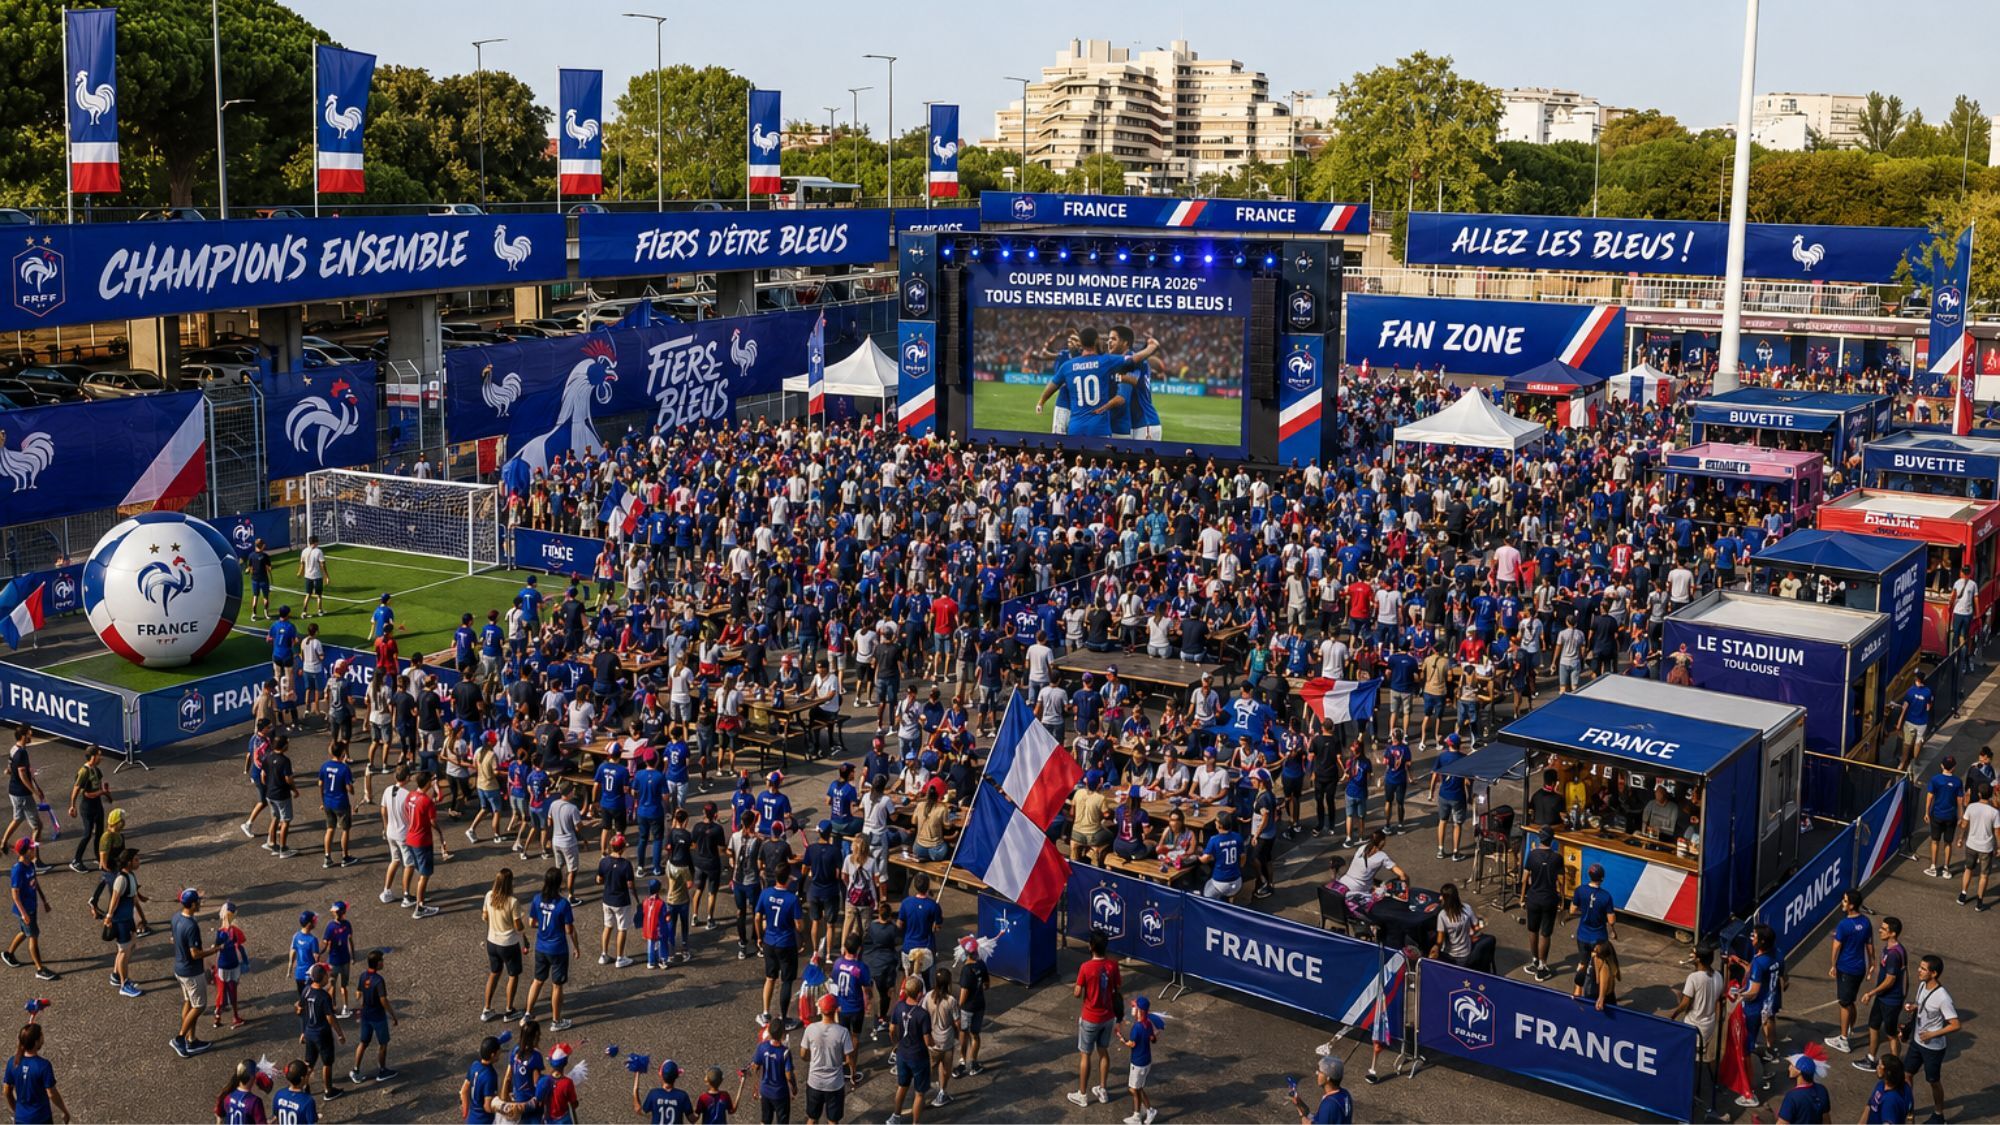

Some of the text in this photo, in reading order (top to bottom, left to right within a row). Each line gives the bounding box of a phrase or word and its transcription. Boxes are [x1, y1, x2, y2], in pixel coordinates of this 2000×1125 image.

[1063, 201, 1127, 218] FRANCE
[1236, 206, 1297, 223] FRANCE
[635, 222, 849, 263] FIERS D'ÊTRE BLEUS
[1451, 226, 1695, 263] ALLEZ LES BLEUS !
[98, 229, 470, 300] CHAMPIONS ENSEMBLE
[1008, 271, 1053, 286] COUPE
[1056, 273, 1075, 287] DU
[1079, 274, 1129, 289] MONDE
[1131, 275, 1161, 290] FIFA
[985, 289, 1233, 312] TOUS ENSEMBLE AVEC LES BLEUS !
[1378, 319, 1526, 355] FAN ZONE
[655, 378, 729, 433] BLEUS
[1073, 374, 1101, 407] 10
[1729, 410, 1794, 428] BUVETTE
[1894, 453, 1966, 473] BUVETTE
[137, 620, 199, 636] FRANCE
[1697, 634, 1805, 666] LE STADIUM
[1723, 657, 1780, 677] TOULOUSE
[10, 682, 91, 728] FRANCE
[1578, 727, 1681, 760] FRANCE
[1784, 857, 1842, 936] FRANCE
[771, 905, 781, 927] 7
[1204, 925, 1324, 985] FRANCE
[1514, 1011, 1658, 1076] FRANCE
